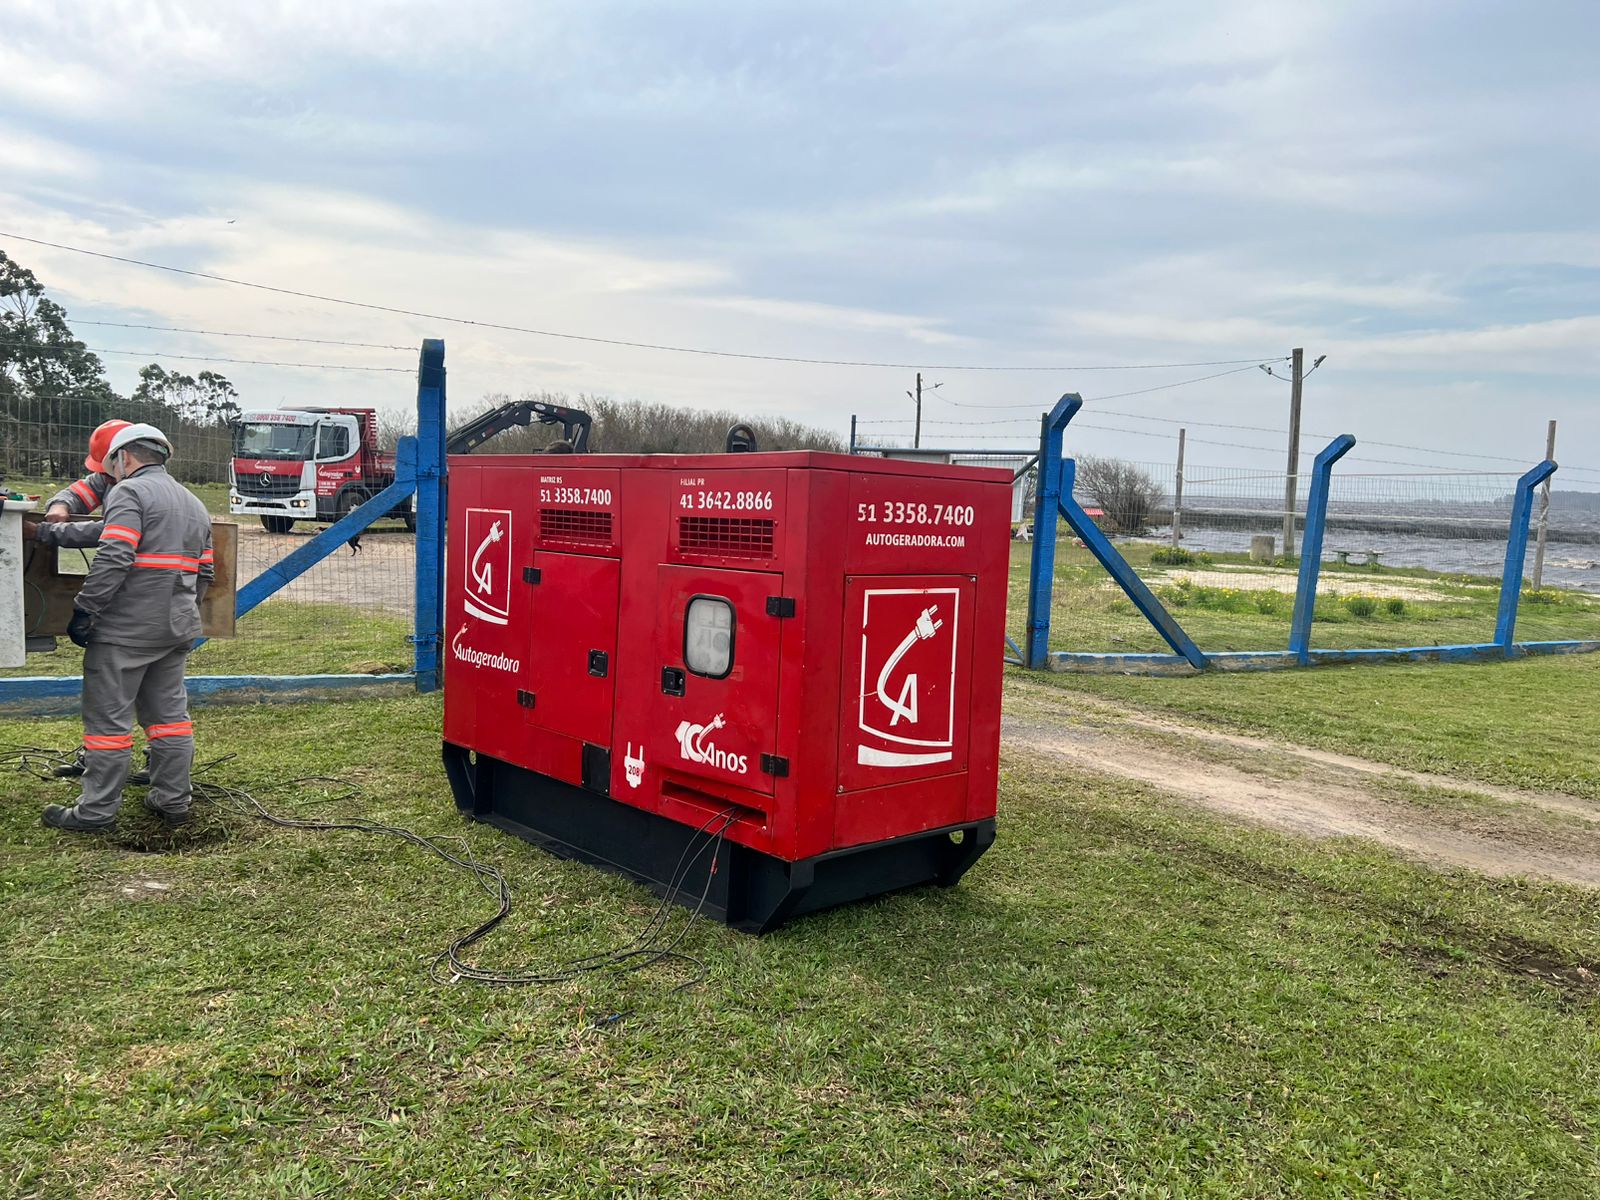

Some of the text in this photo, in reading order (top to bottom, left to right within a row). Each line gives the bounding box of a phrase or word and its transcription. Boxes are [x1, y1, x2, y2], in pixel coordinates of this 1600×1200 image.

[680, 478, 705, 486] FILIAL PR
[540, 487, 612, 506] 51 3358.7400
[680, 490, 773, 511] 41 3642.8866
[857, 502, 877, 522] 51
[865, 533, 966, 548] AUTOGERADORA.COM
[454, 643, 520, 674] Autogeradora
[628, 764, 640, 777] 208
